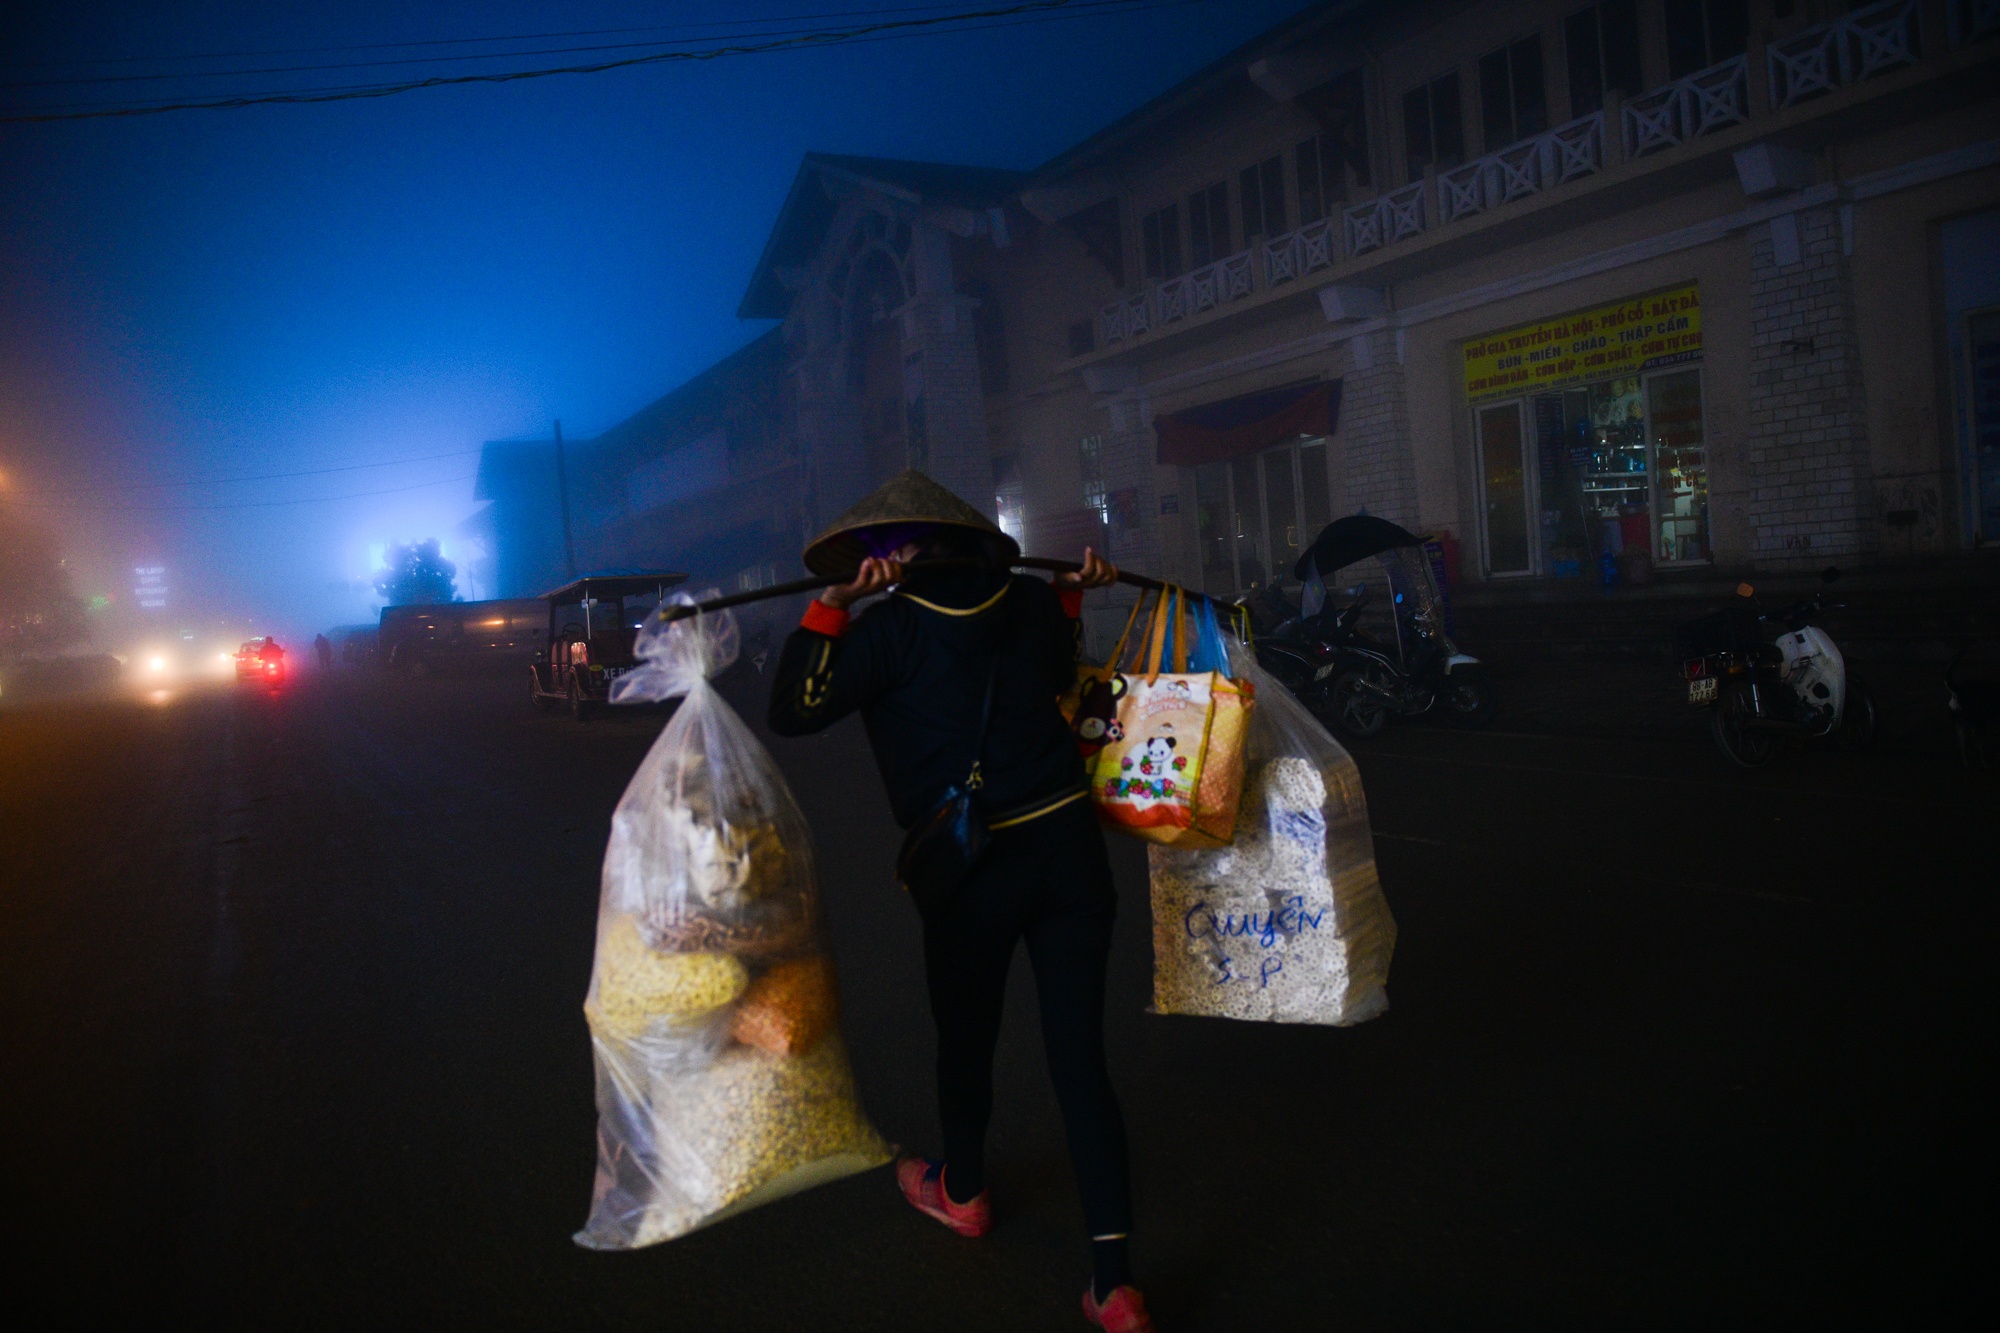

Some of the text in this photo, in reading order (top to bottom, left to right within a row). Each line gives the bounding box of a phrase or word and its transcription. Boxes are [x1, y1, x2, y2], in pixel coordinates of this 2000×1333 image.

[1488, 341, 1506, 354] GIA
[1572, 318, 1593, 336] NỘI
[1498, 354, 1521, 370] BÚN
[1573, 335, 1606, 353] CHÁO
[1618, 325, 1653, 342] THẬP
[1677, 352, 1691, 361] 777
[603, 667, 616, 680] XE
